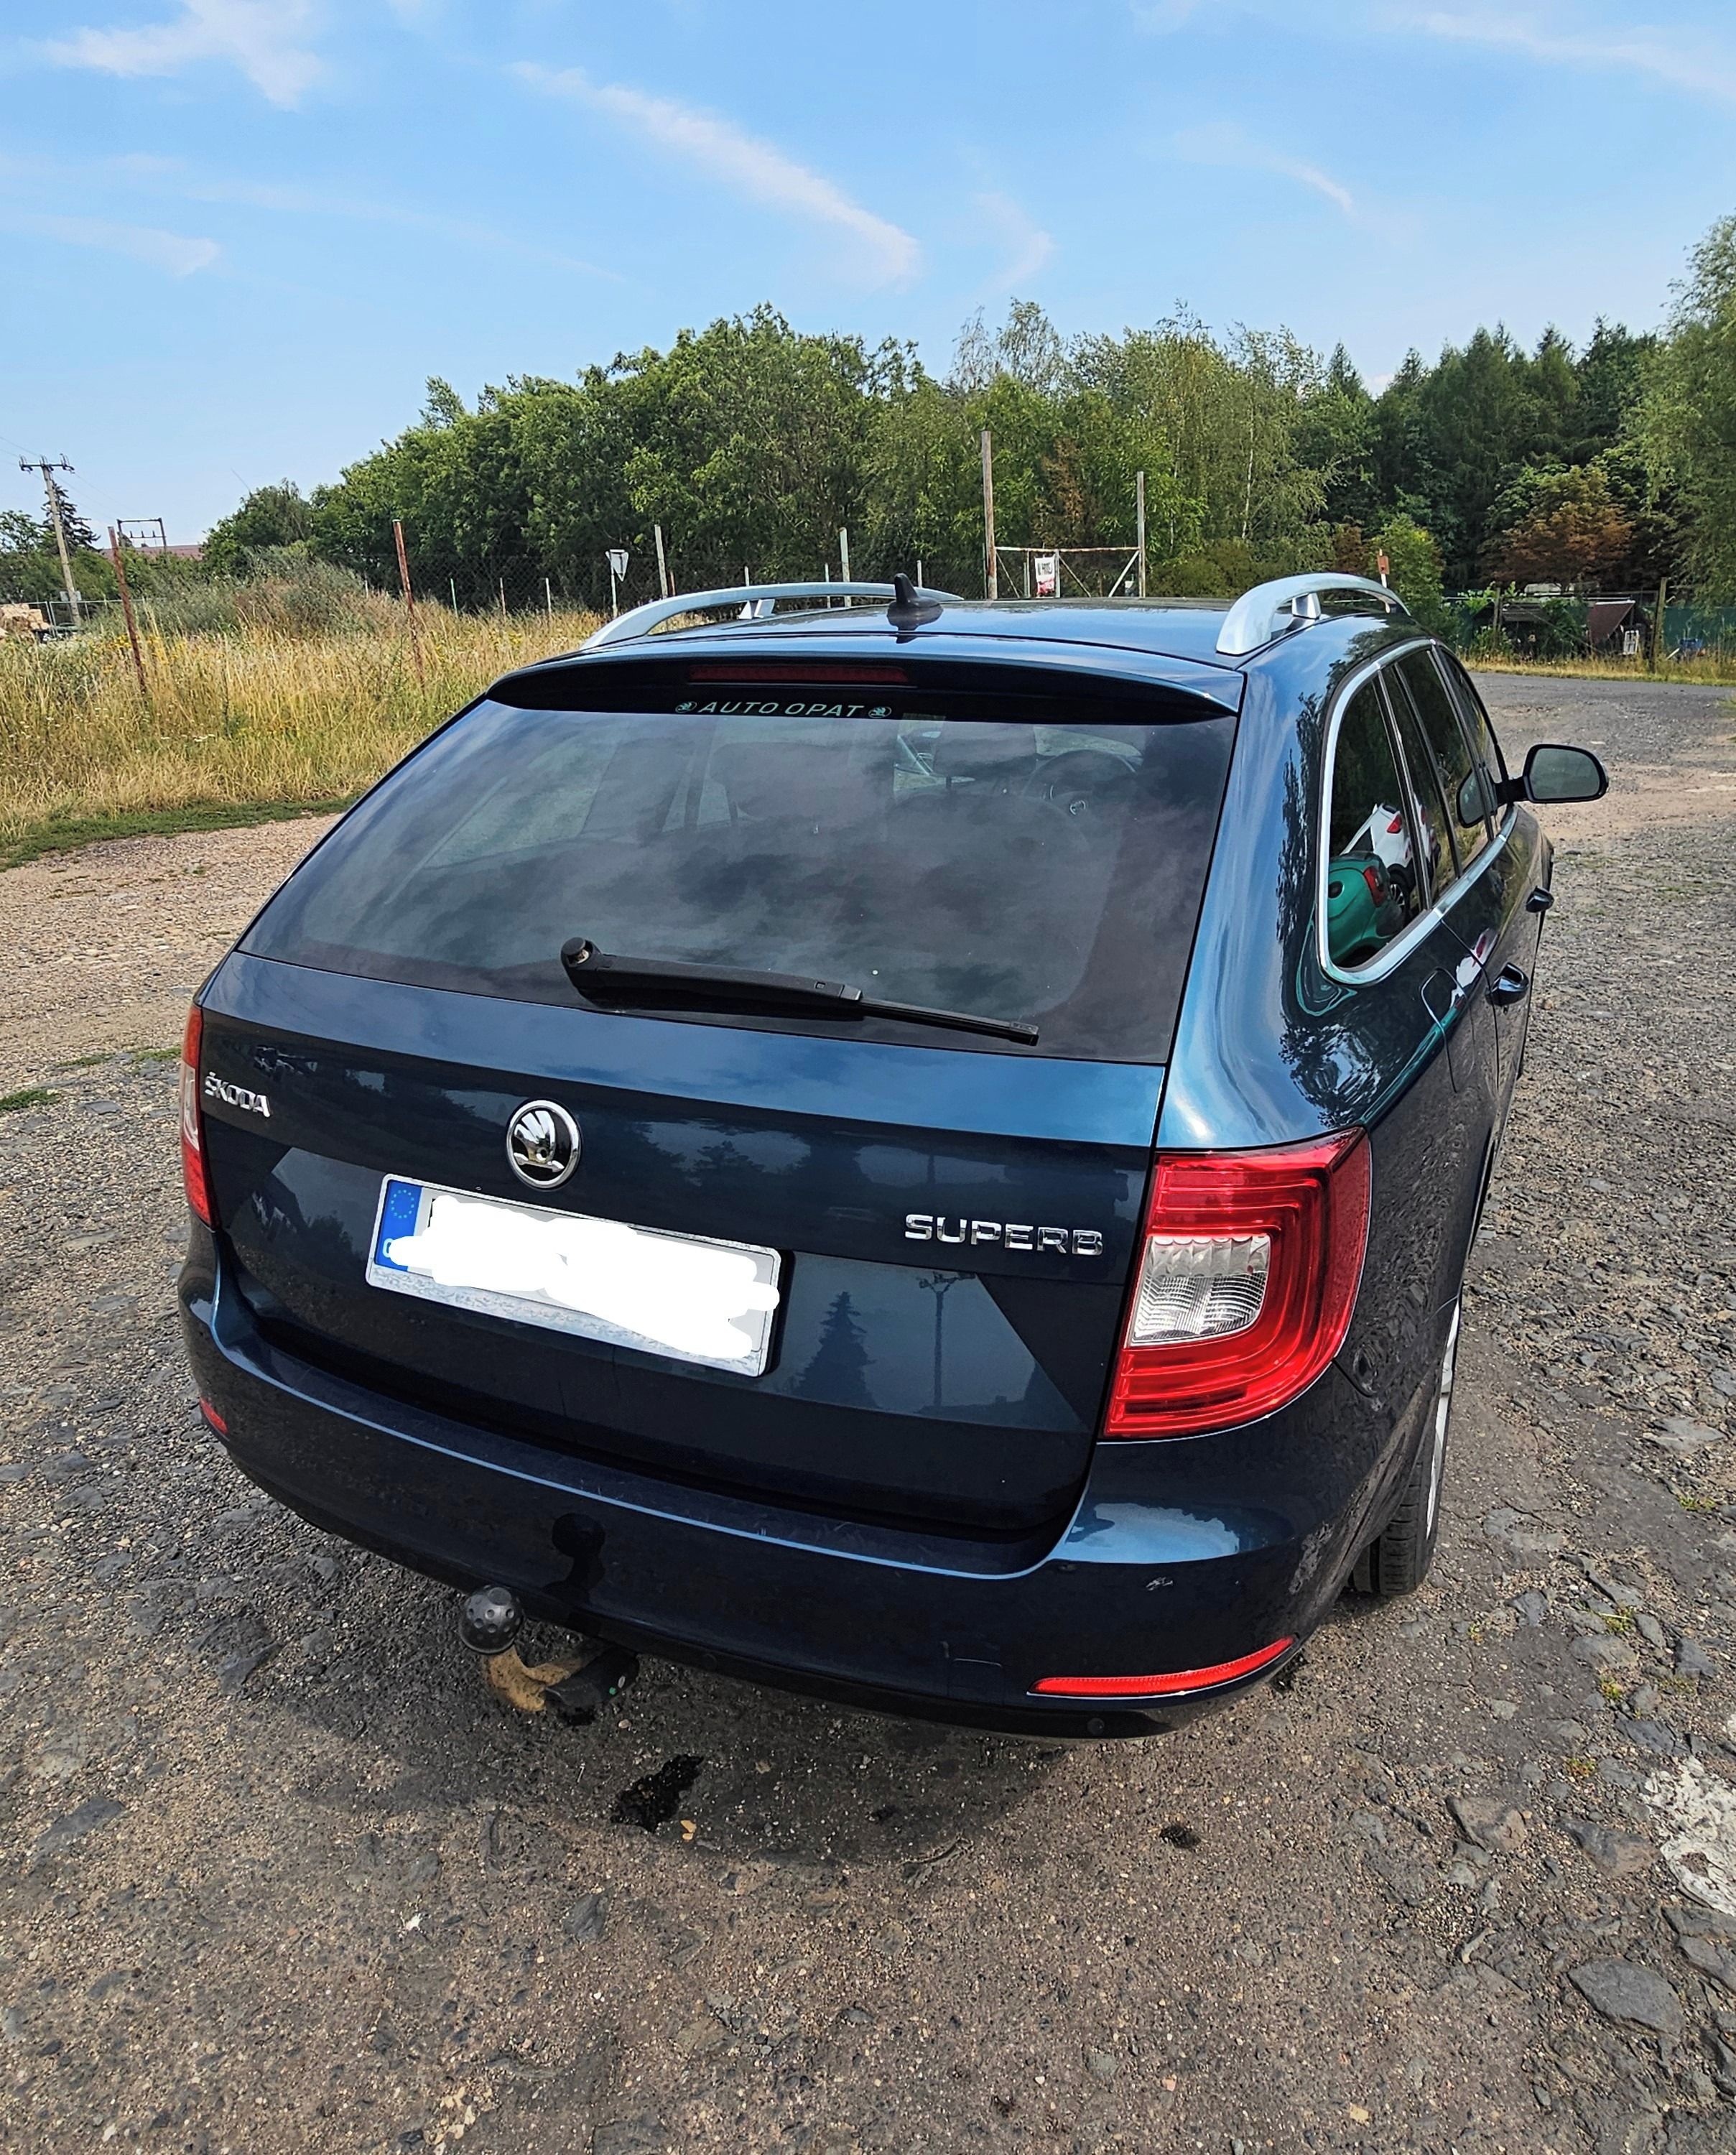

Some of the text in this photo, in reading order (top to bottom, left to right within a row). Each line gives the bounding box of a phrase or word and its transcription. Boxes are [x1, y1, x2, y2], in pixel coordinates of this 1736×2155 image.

[697, 701, 864, 717] AUTO OPAT
[904, 1213, 1103, 1256] SUPERB
